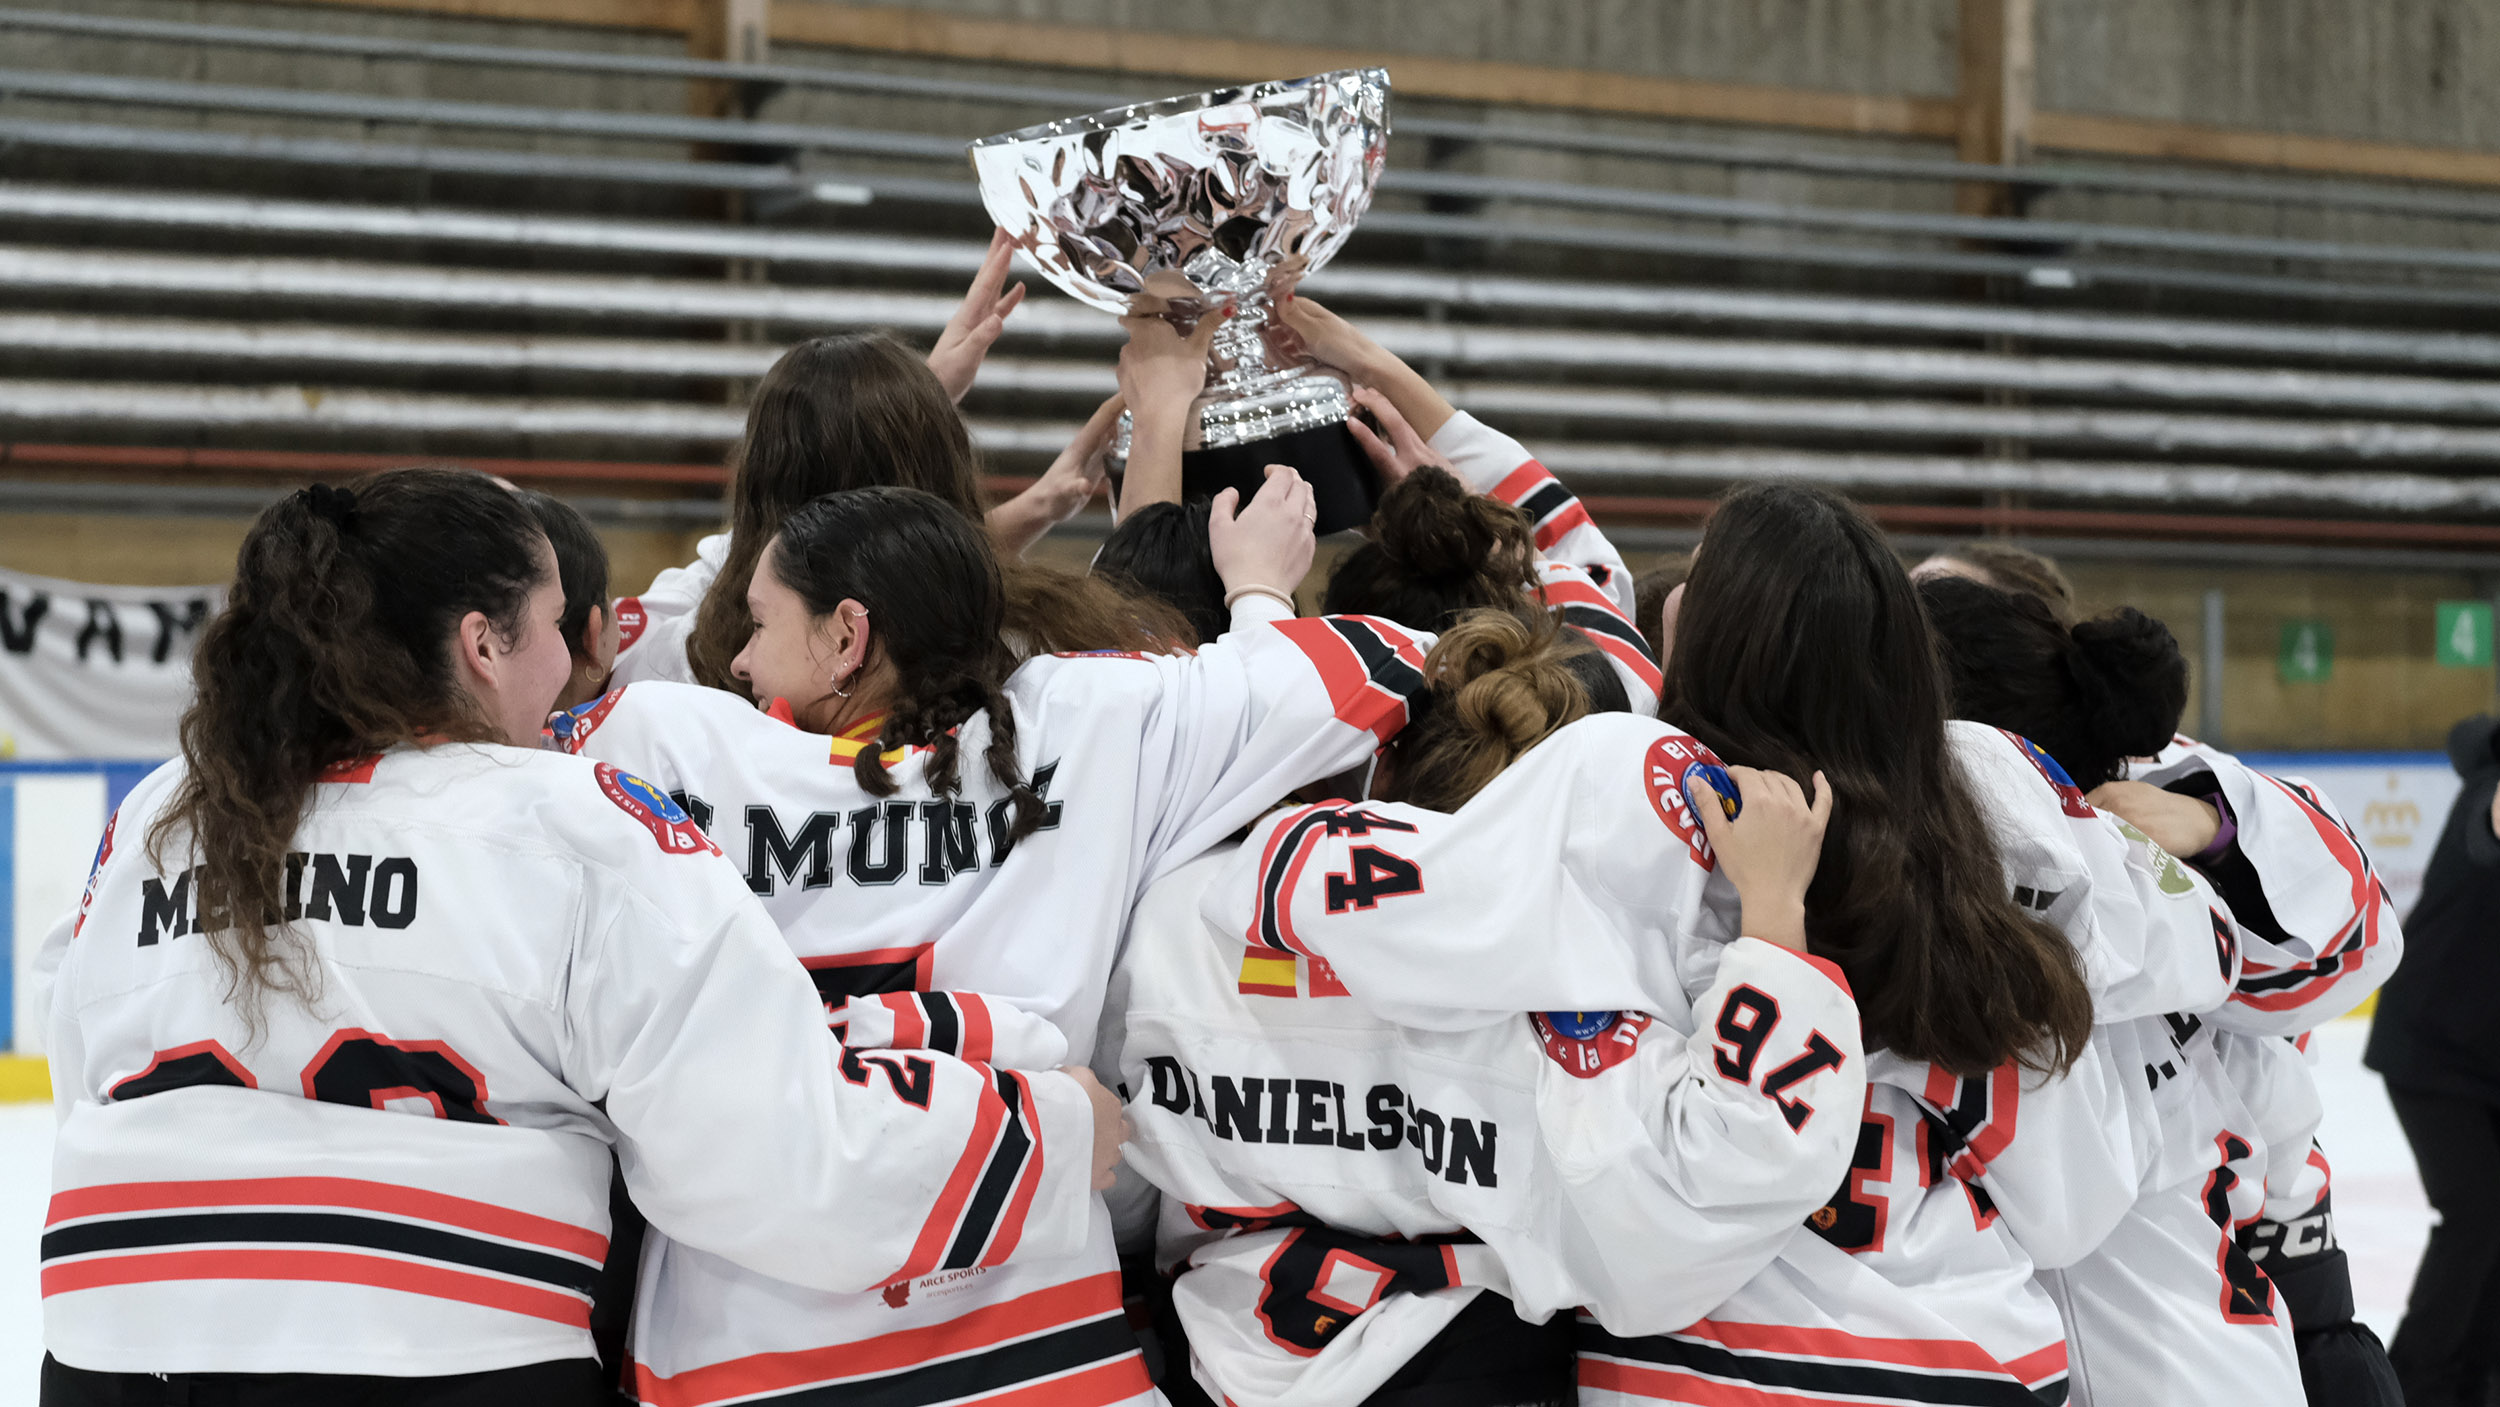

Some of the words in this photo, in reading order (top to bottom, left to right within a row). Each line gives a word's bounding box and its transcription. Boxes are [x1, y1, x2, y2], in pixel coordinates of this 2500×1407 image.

[137, 852, 418, 947] MEINO
[919, 1275, 946, 1289] ARCE
[947, 1266, 987, 1281] SPORTS
